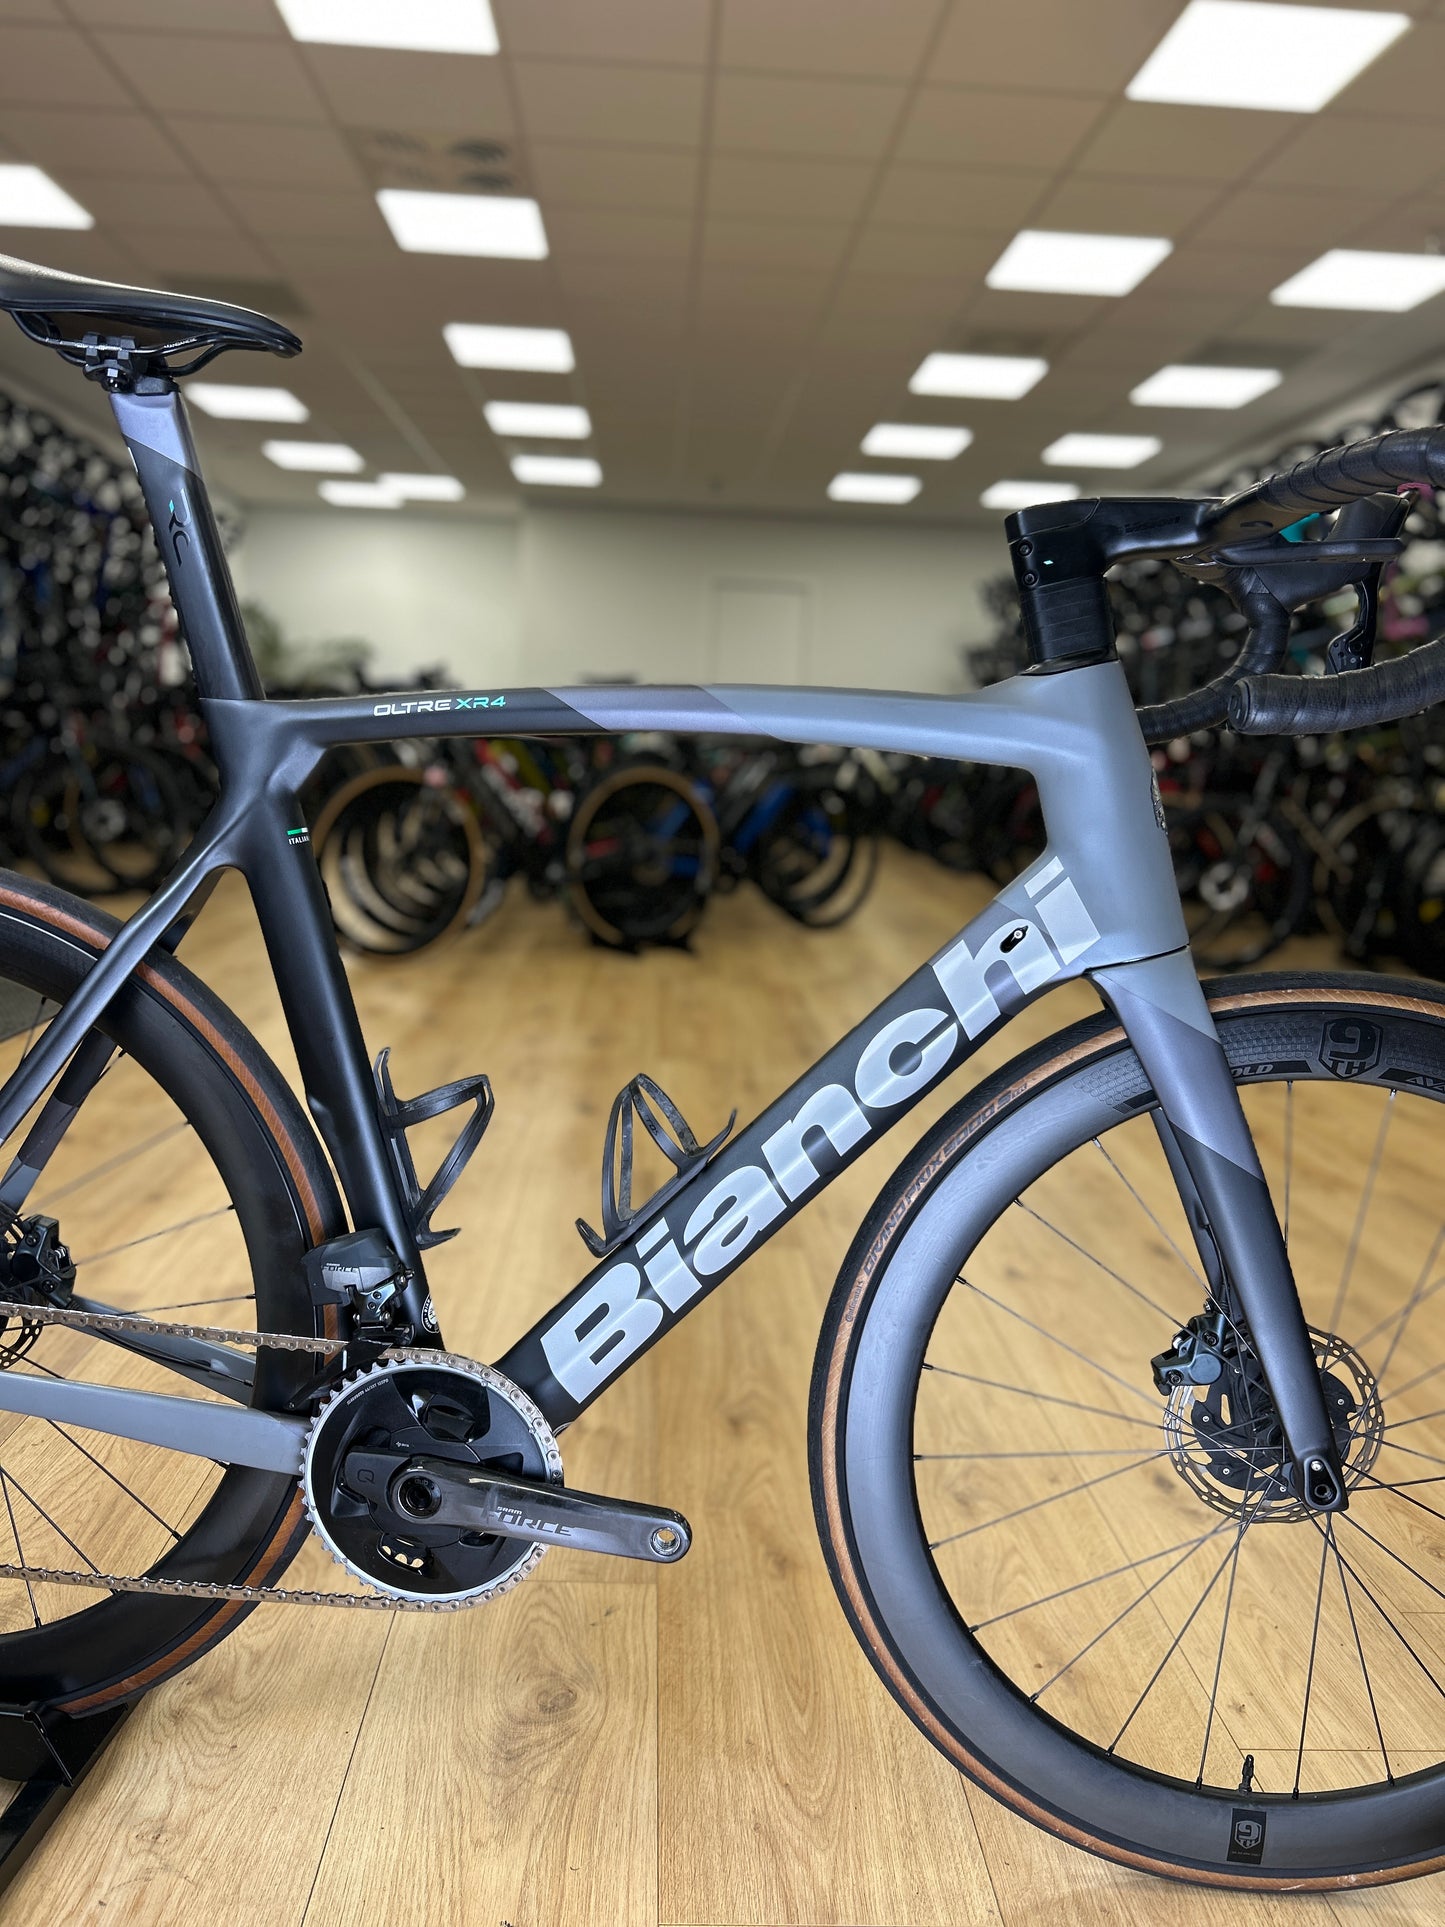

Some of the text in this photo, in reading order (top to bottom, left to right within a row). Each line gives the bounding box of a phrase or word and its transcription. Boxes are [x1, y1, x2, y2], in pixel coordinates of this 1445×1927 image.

[373, 695, 506, 717] OLTRE XR4
[540, 856, 1100, 1403] Bianchi
[863, 1198, 907, 1277] GRAND
[905, 1152, 943, 1207] PRIX
[943, 1103, 997, 1158] 5000
[488, 1509, 572, 1537] FORCE
[497, 1506, 523, 1515] SRAM
